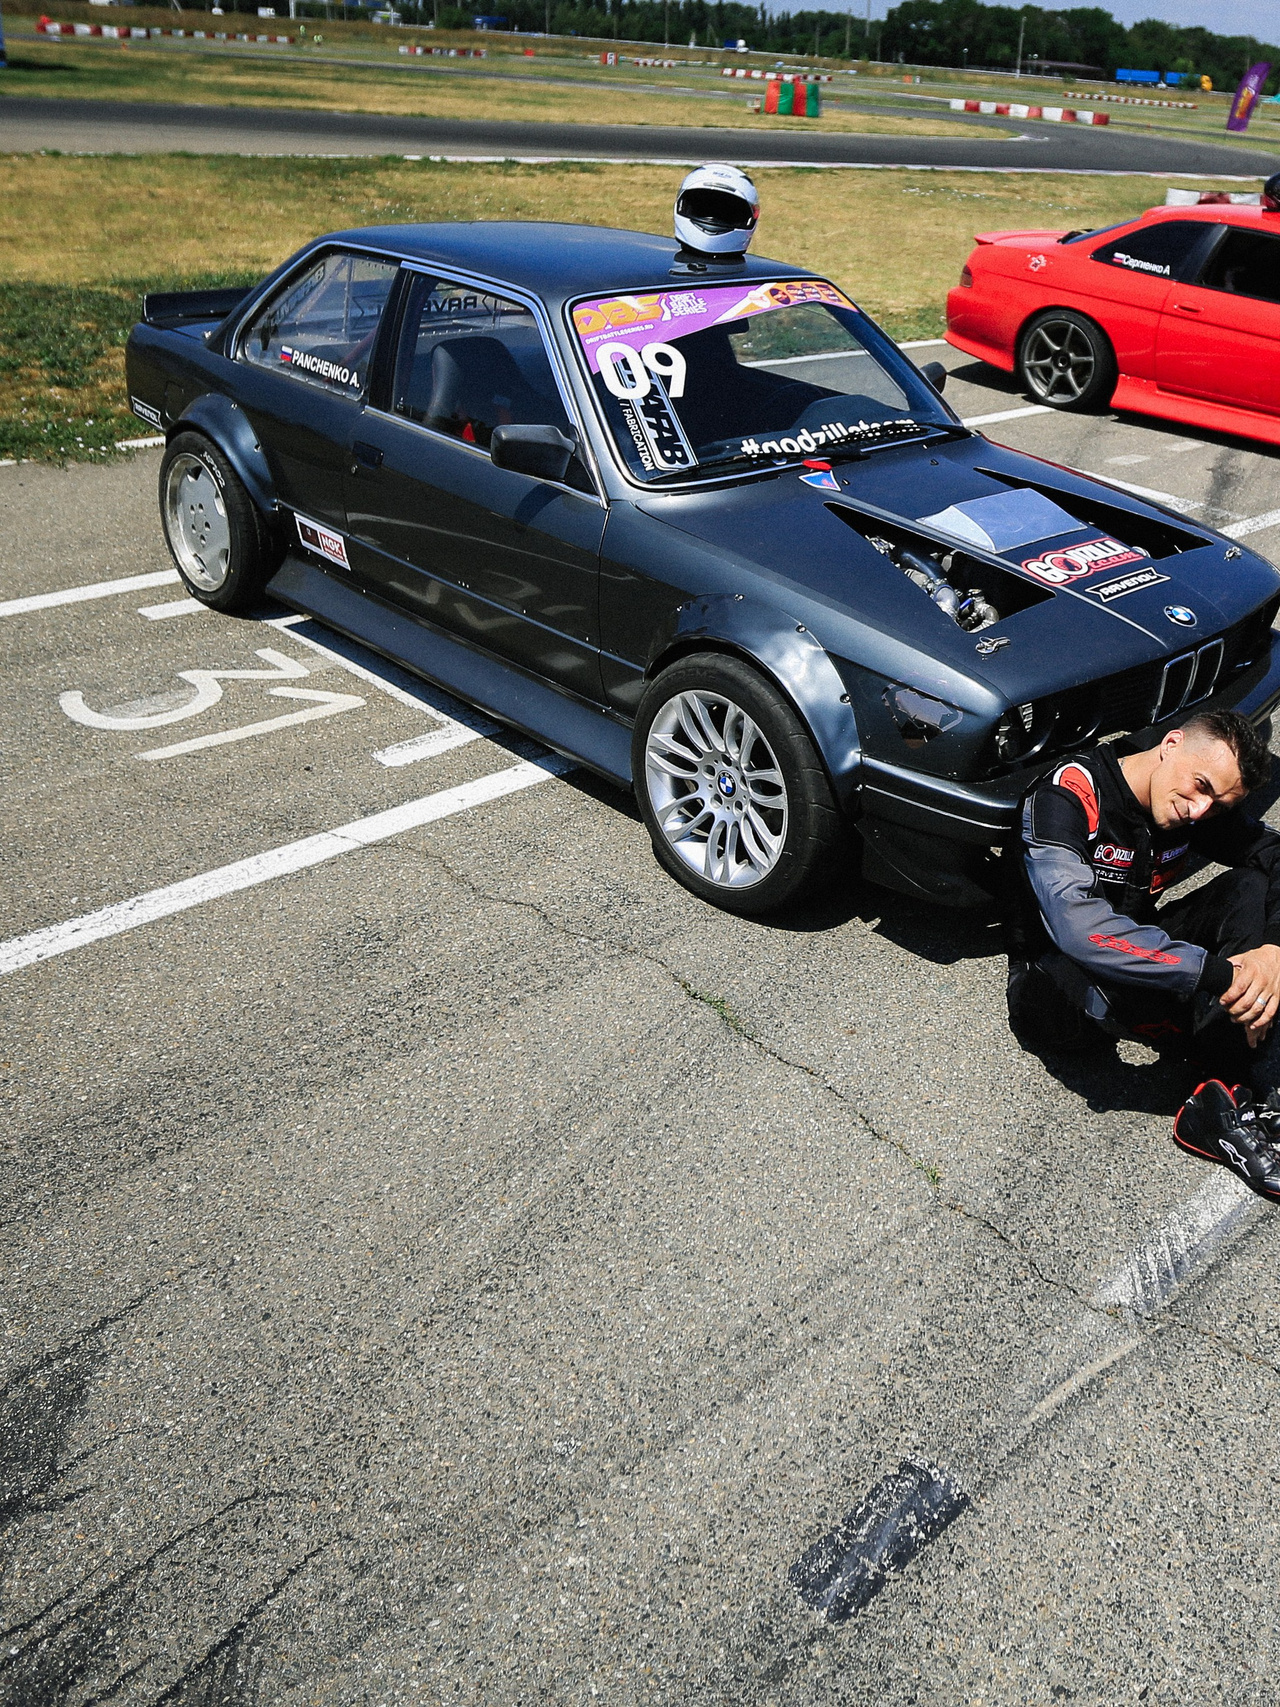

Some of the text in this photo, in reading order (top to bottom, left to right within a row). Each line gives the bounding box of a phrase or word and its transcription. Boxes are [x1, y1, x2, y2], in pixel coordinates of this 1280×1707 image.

[669, 292, 695, 302] DRIFT
[669, 298, 707, 310] BATTLE
[670, 306, 708, 317] SERIES
[573, 294, 663, 335] DBS
[292, 350, 360, 388] PANCHENKO A.
[596, 342, 686, 398] 09
[622, 408, 655, 471] FABRICATION
[320, 533, 341, 553] NGK
[1027, 540, 1131, 583] GODZILLA
[1099, 572, 1158, 596] RAVENOL
